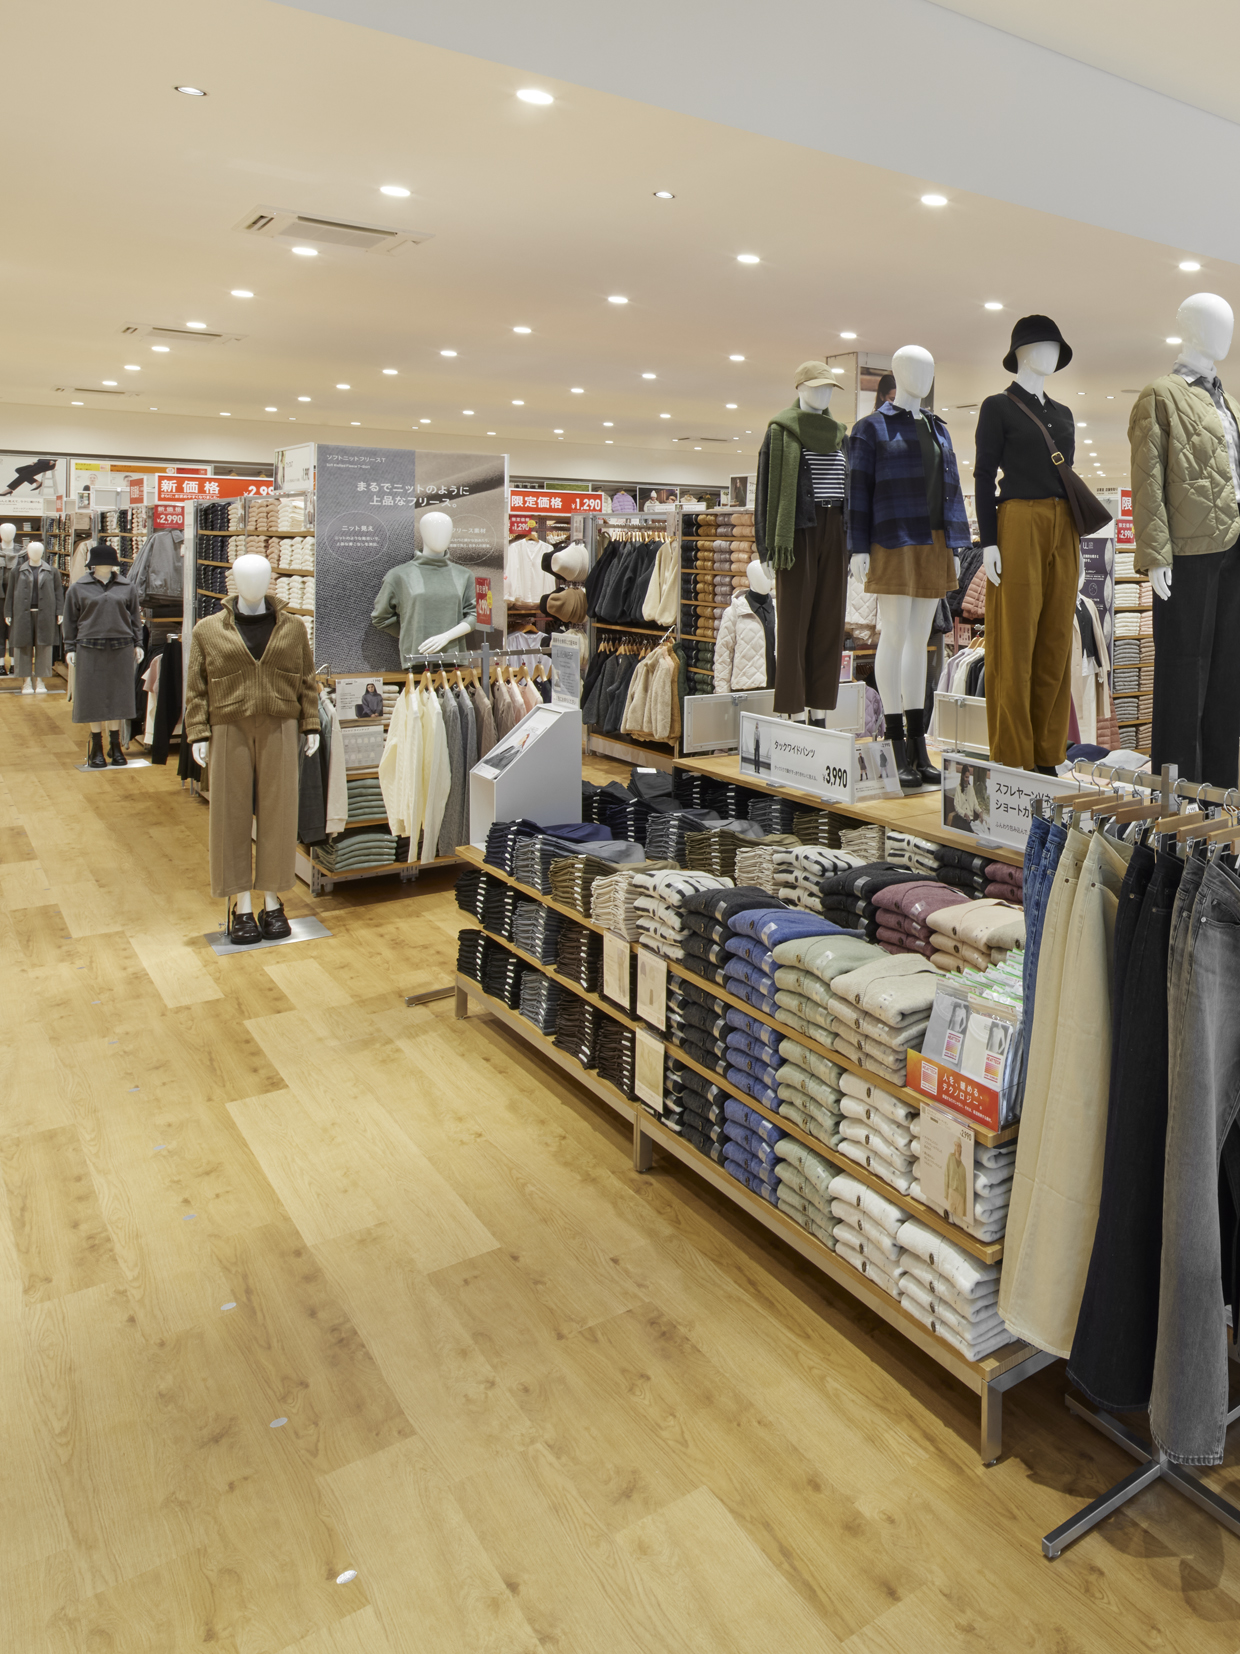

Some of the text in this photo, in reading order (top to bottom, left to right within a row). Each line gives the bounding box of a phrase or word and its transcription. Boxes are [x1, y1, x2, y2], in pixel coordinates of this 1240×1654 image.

[160, 479, 220, 494] 新価格
[357, 481, 470, 495] まるでニットのように
[369, 495, 458, 508] 上品なフリース。
[511, 495, 601, 511] 限定価格 ¥1,290
[157, 515, 183, 524] ¥2,990
[774, 740, 816, 759] タックワイドパンツ
[822, 765, 848, 789] ¥3,990
[942, 1073, 983, 1100] 人を、暖める、
[942, 1083, 983, 1110] テクノロジー。
